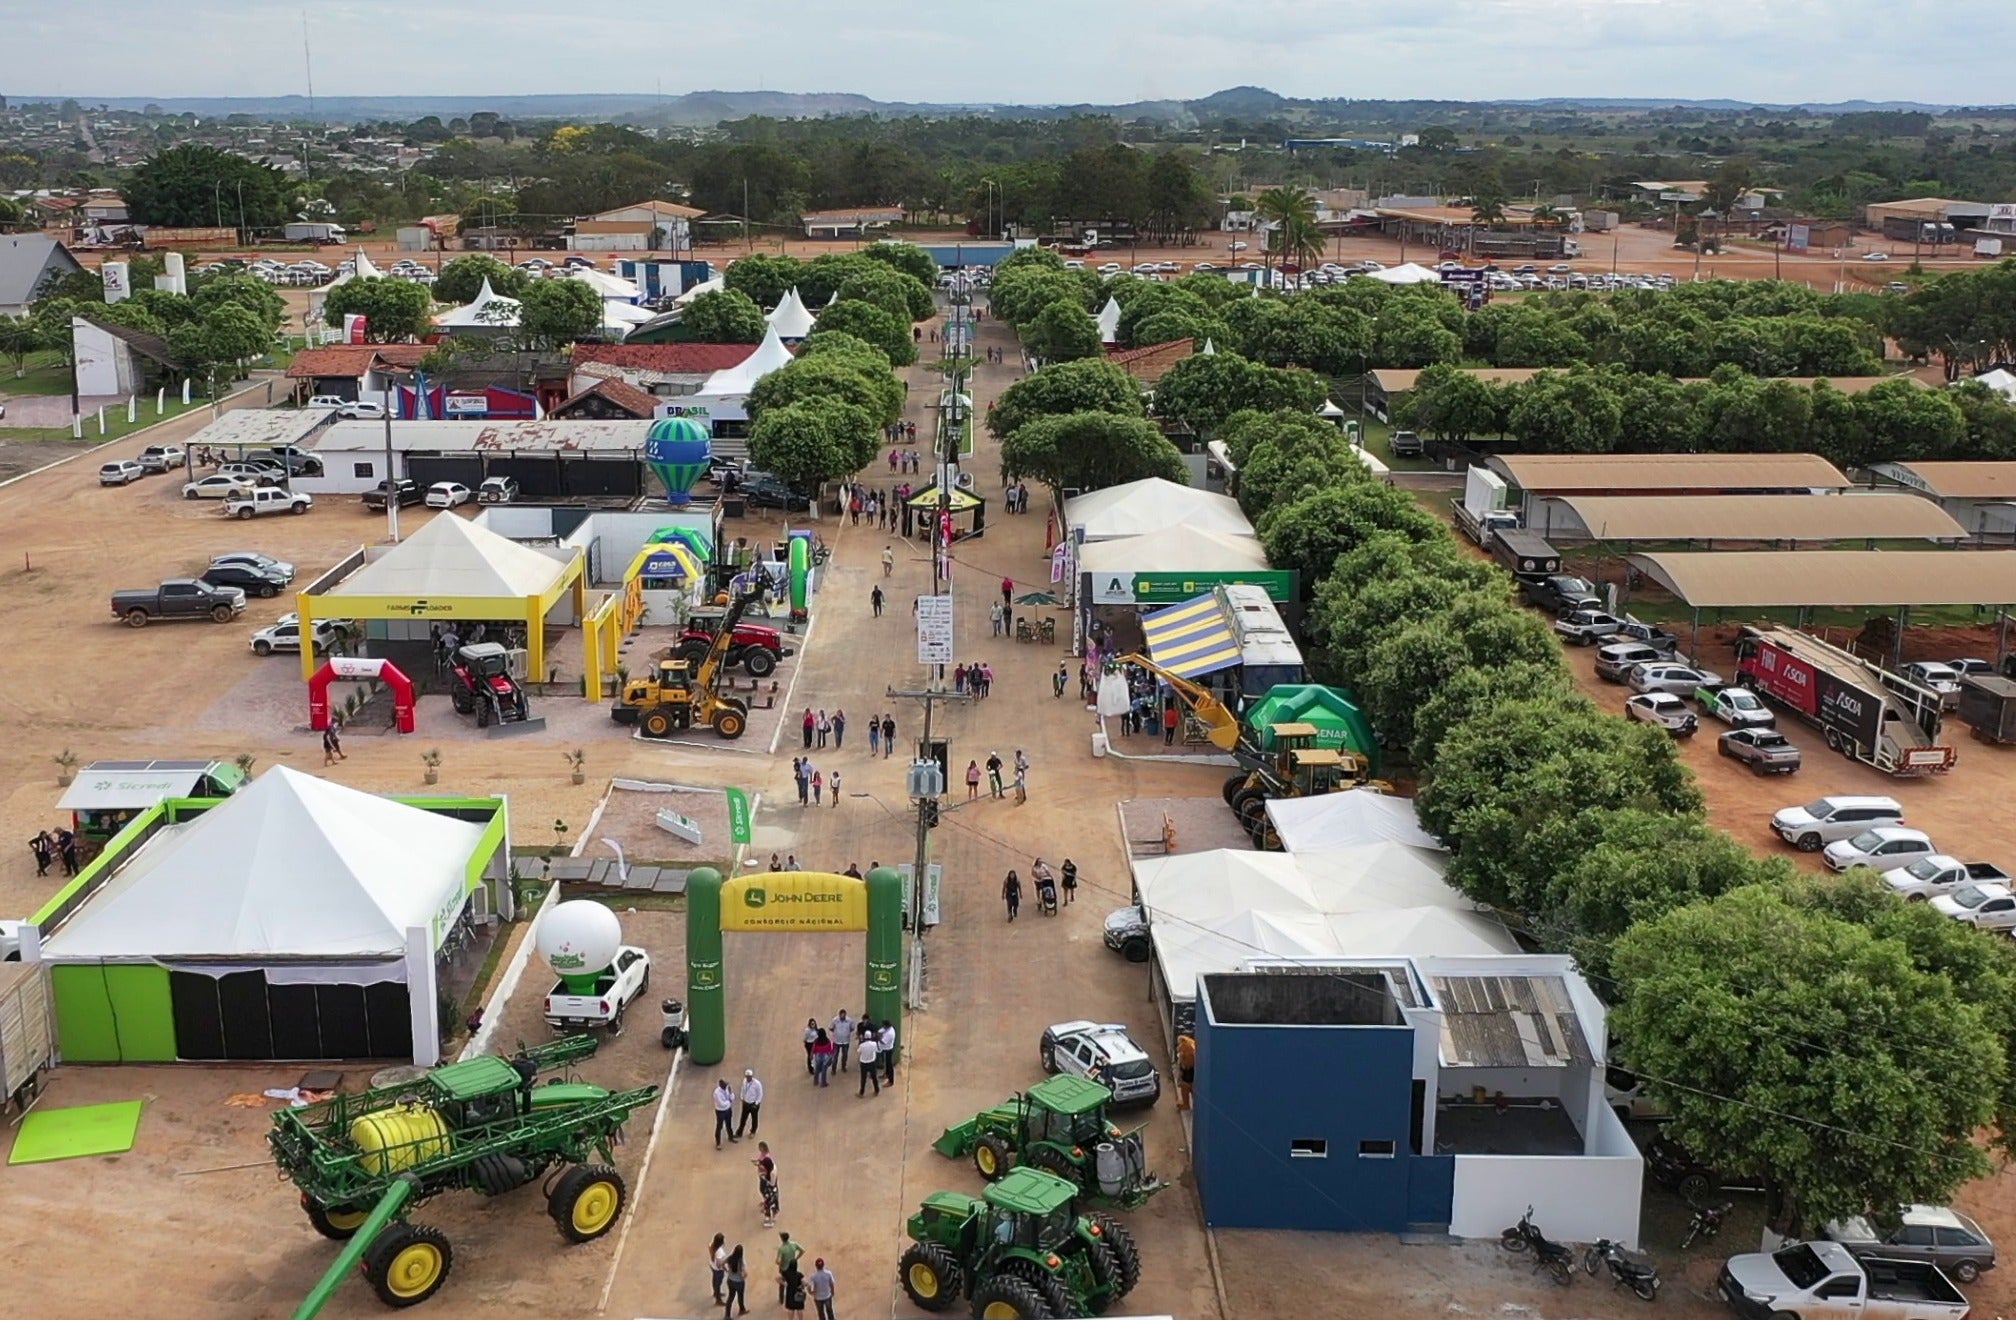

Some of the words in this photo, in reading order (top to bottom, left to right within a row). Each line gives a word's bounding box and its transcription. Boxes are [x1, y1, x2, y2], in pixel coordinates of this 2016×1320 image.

[667, 406, 710, 417] BRASIL
[116, 781, 173, 791] Sicredi
[770, 892, 803, 904] JOHN
[804, 892, 843, 903] DEERE
